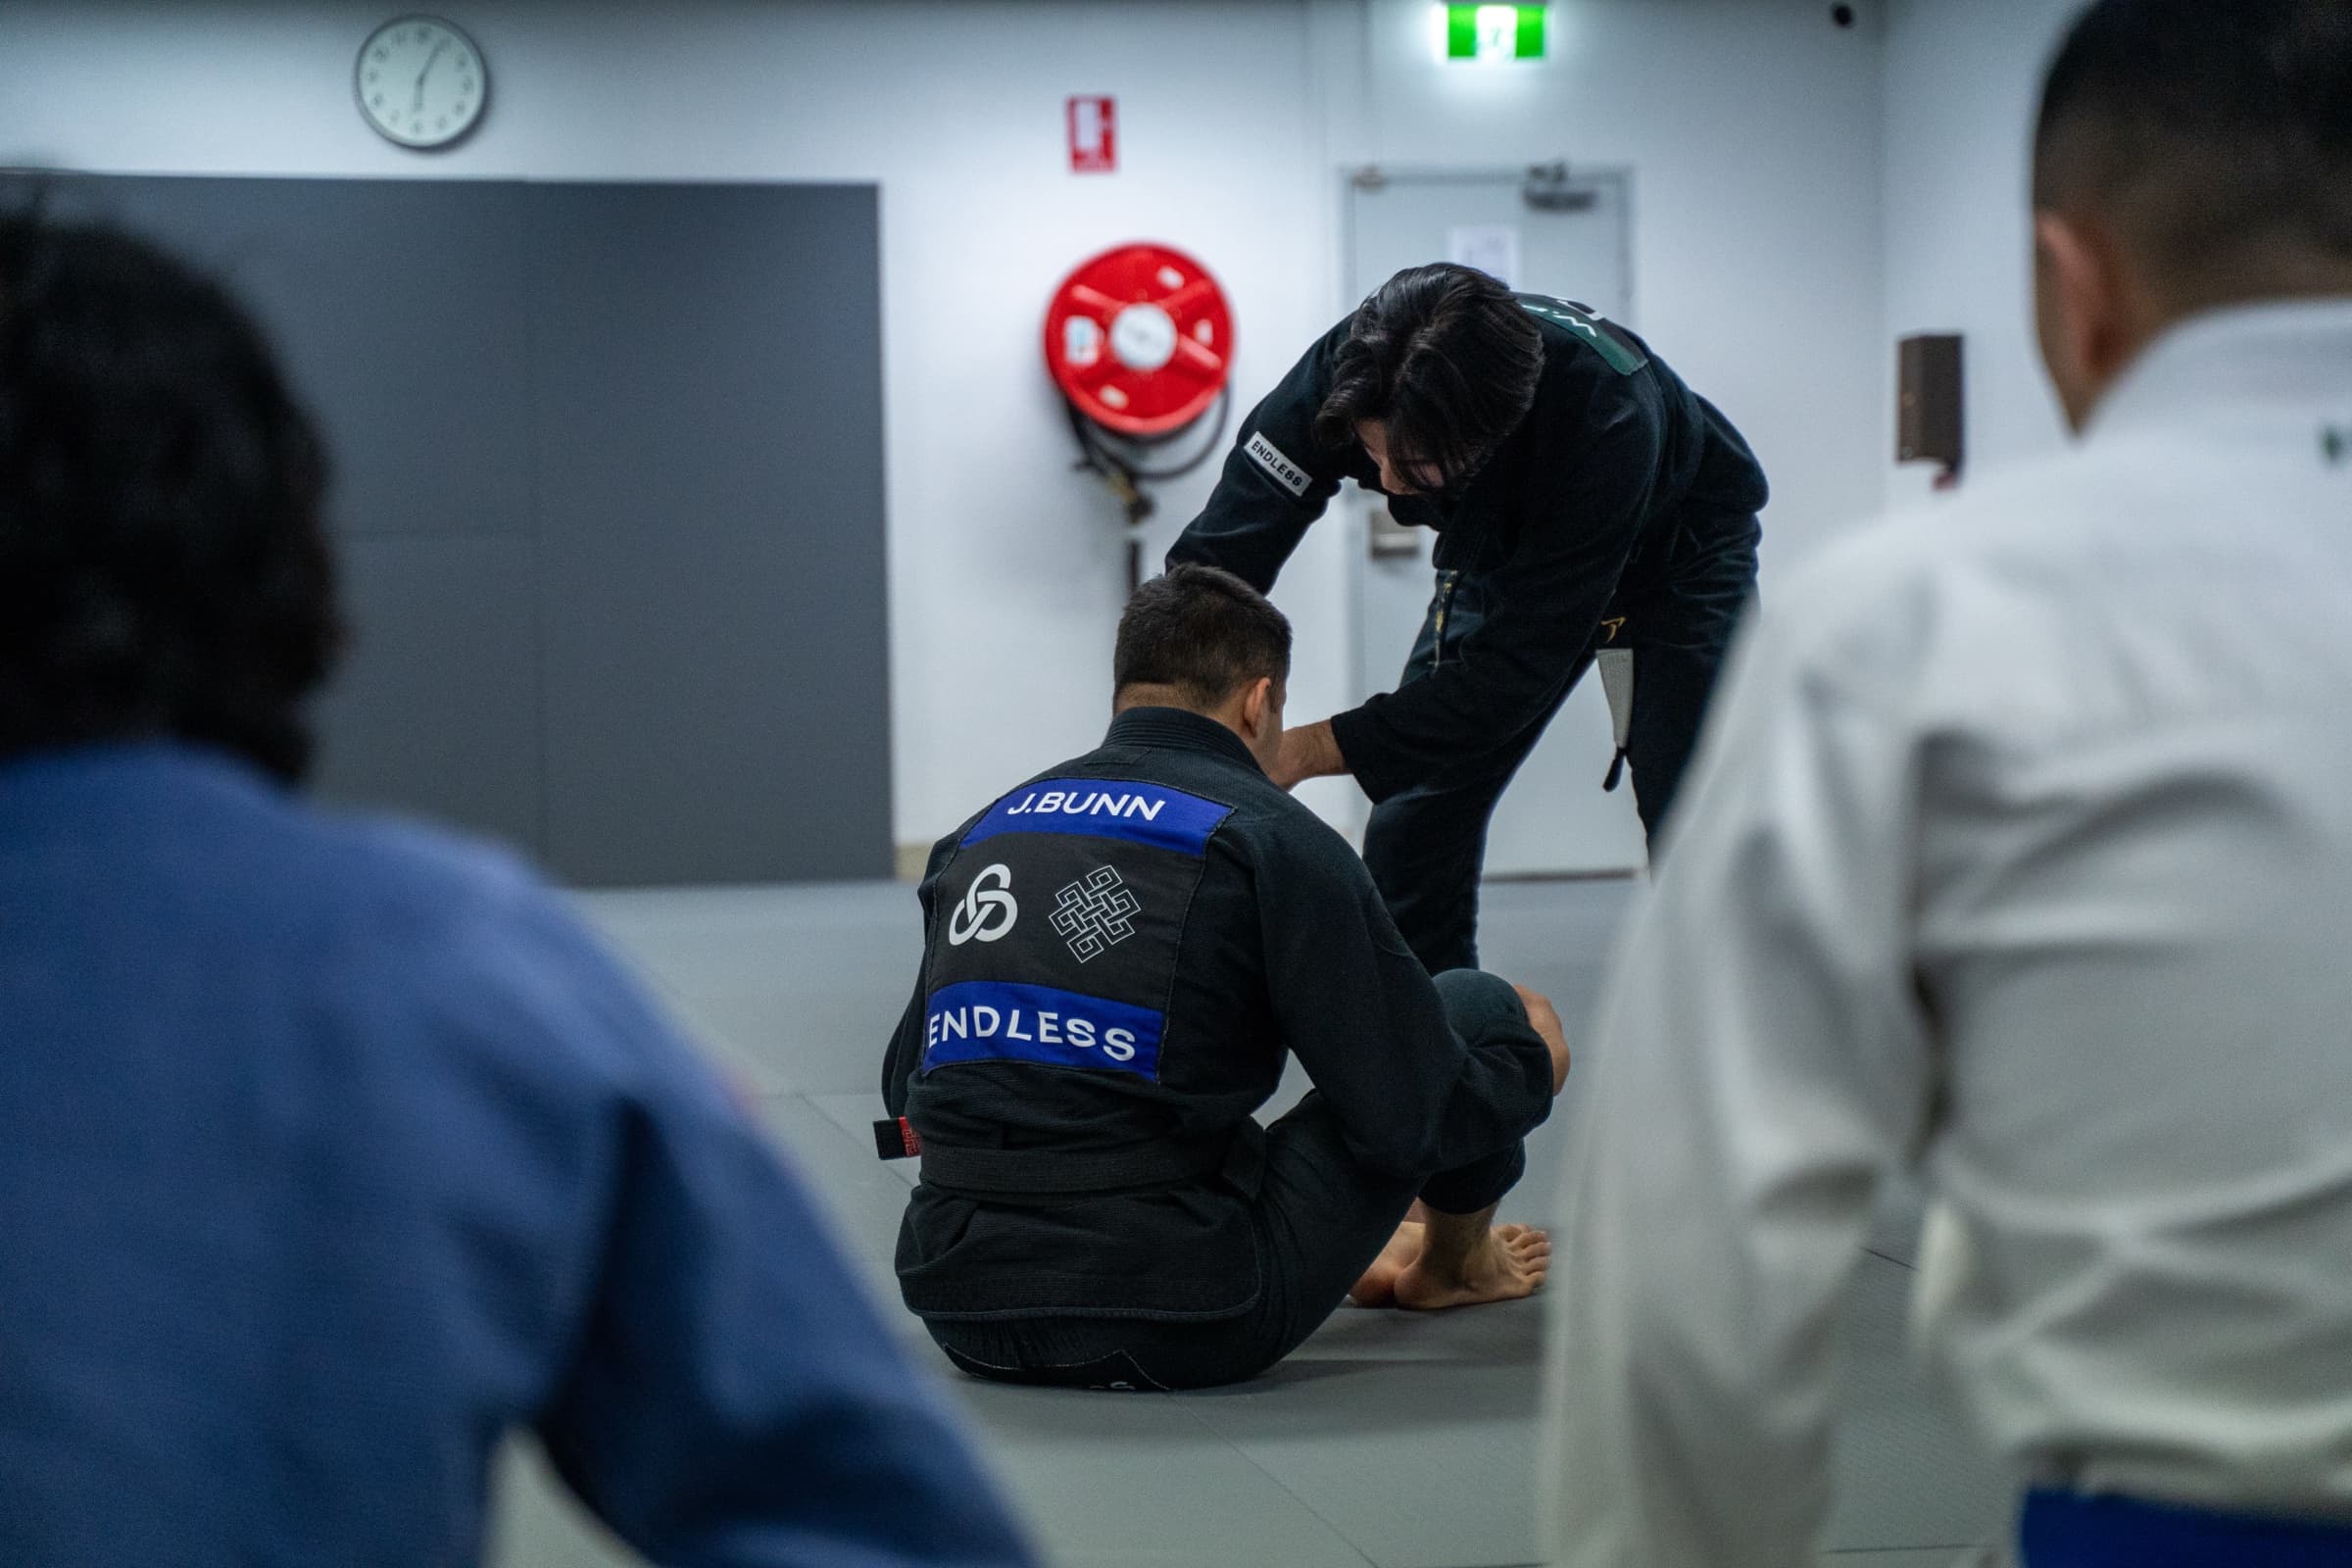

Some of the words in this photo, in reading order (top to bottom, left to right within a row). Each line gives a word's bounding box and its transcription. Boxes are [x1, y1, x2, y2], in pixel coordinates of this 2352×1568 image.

[1251, 440, 1302, 487] ENDLESS
[1007, 791, 1166, 821] J.BUNN
[928, 1005, 1136, 1062] ENDLESS
